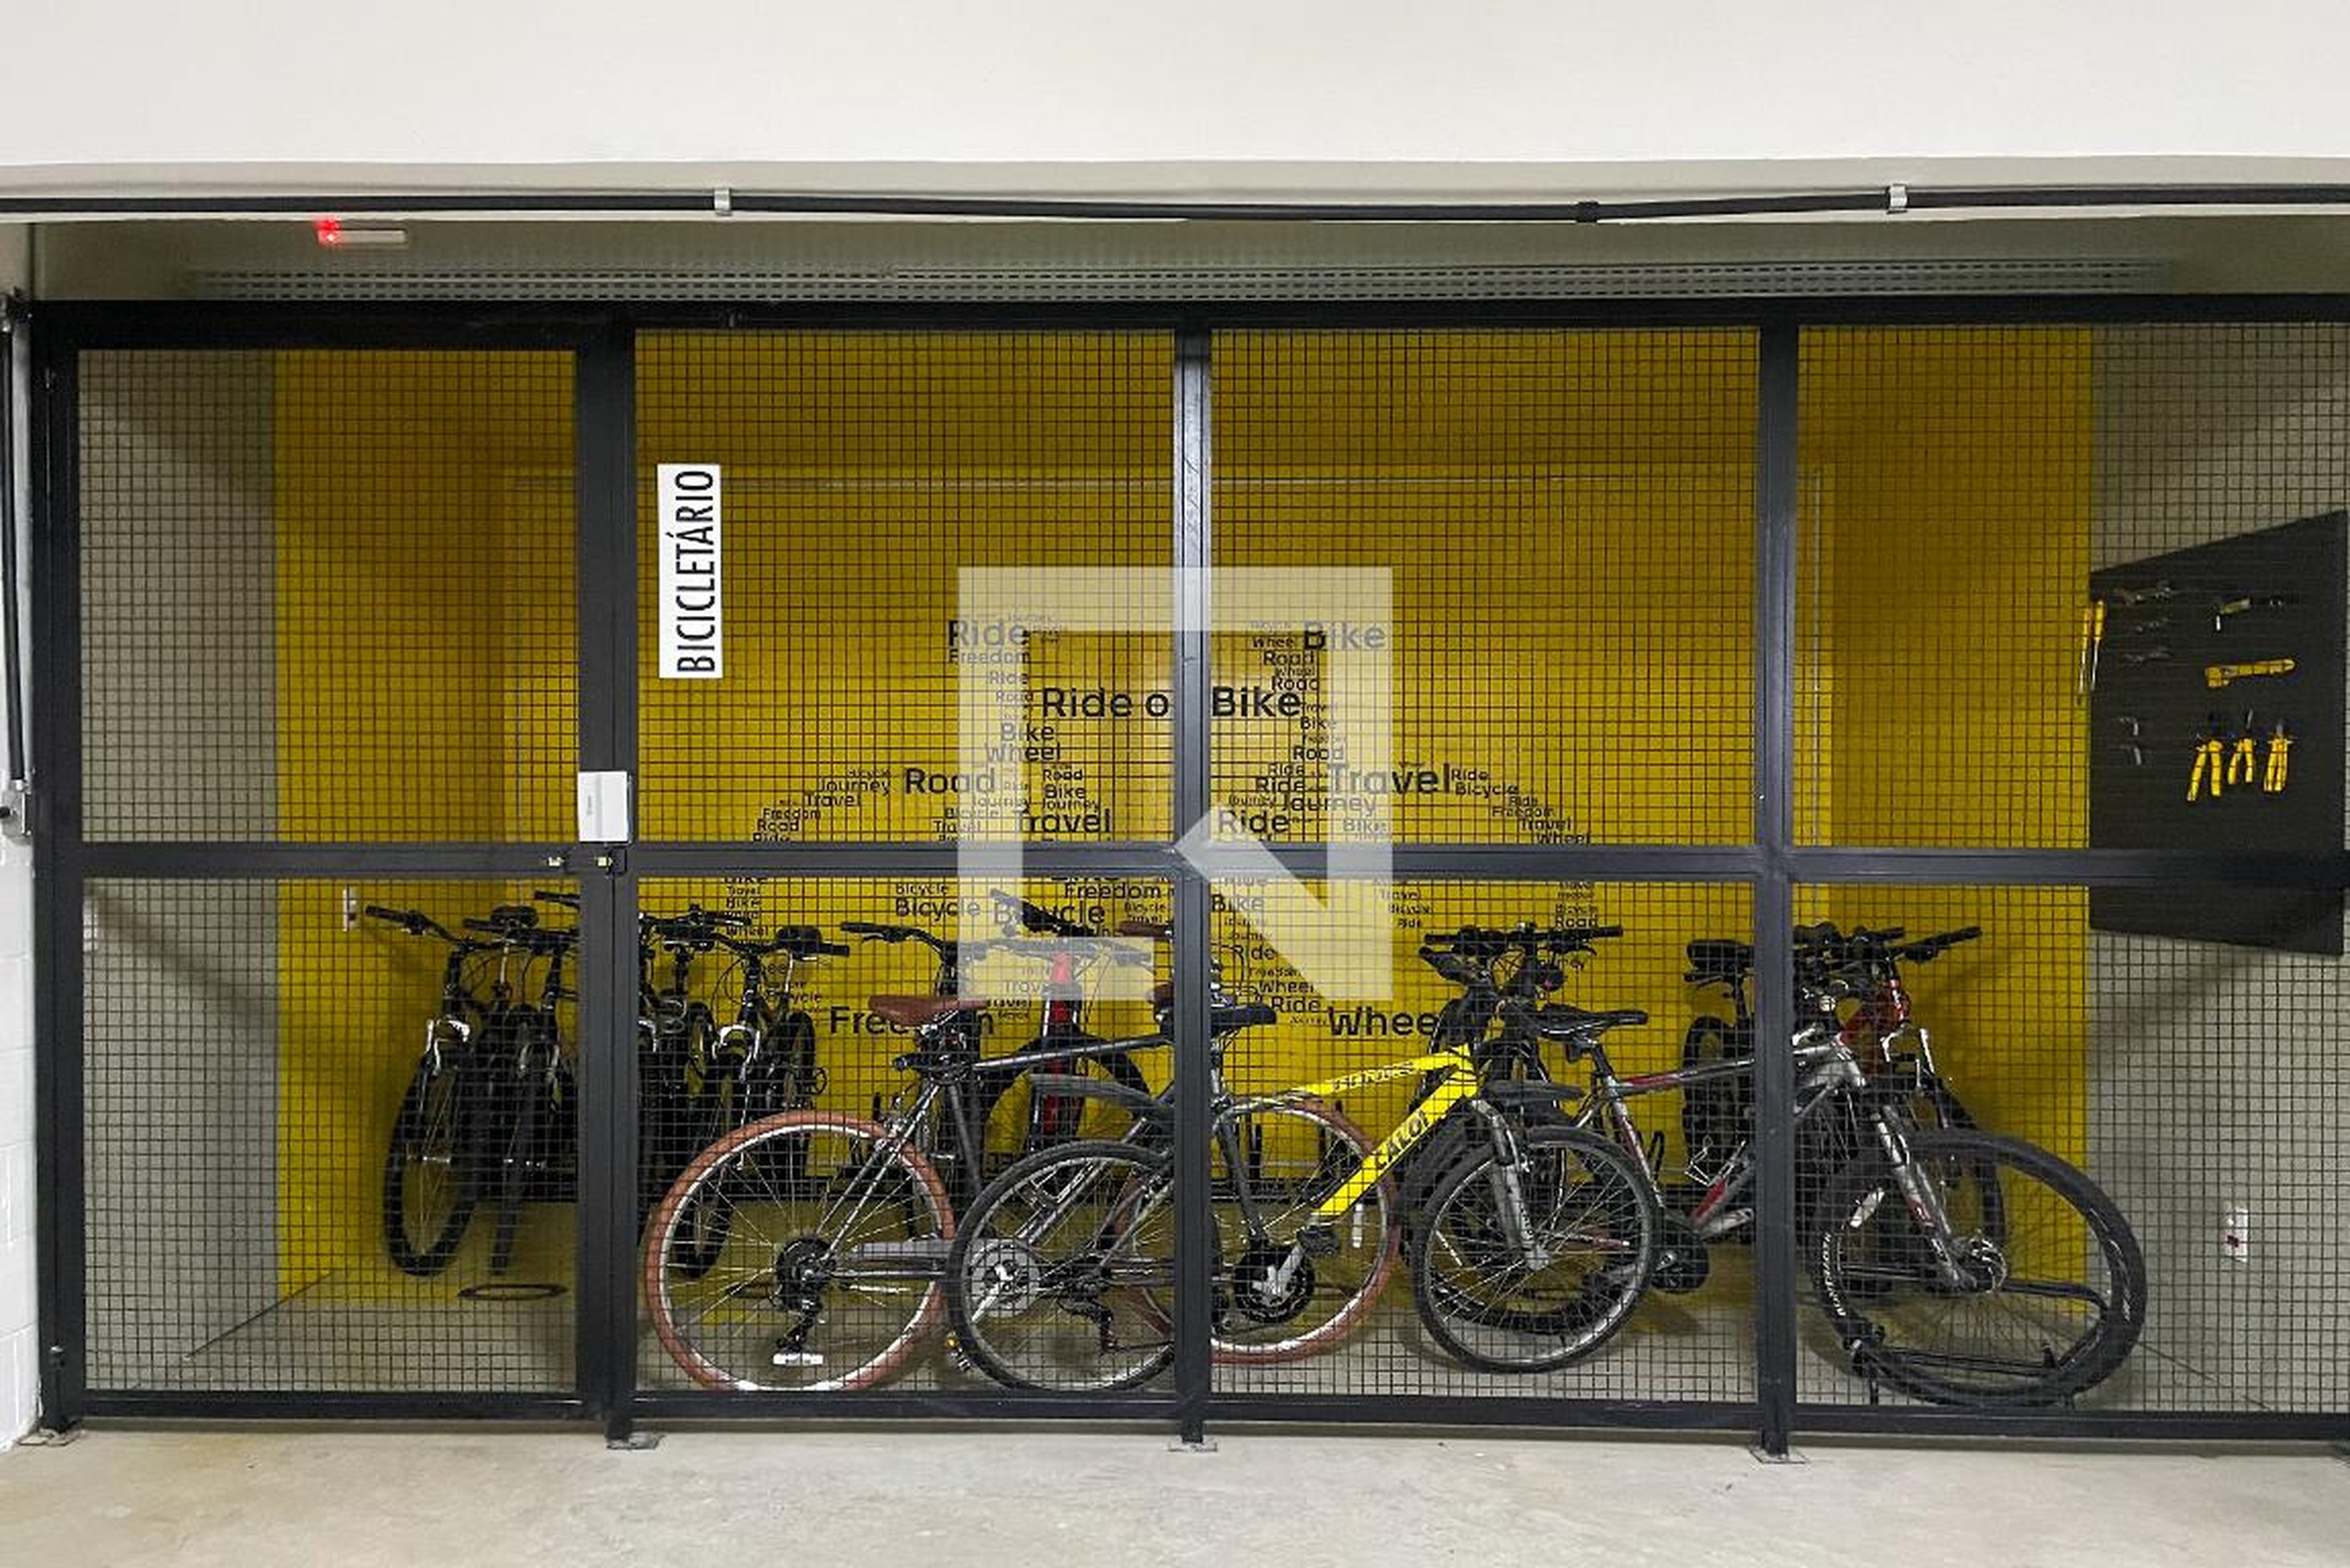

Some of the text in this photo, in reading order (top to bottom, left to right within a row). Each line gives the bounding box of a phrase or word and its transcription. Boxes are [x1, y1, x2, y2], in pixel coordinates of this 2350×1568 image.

[665, 471, 715, 671] BICICLETÁRIO
[948, 619, 1029, 646] Ride
[1304, 621, 1386, 650] Bike
[949, 649, 1031, 664] Freedom
[1042, 685, 1301, 717] Ride o Bike
[1001, 722, 1054, 742] Bike
[985, 742, 1061, 763] Wheel
[905, 768, 995, 794] Road
[1042, 769, 1083, 781] Road
[1327, 763, 1450, 794] Travel
[1451, 768, 1490, 781] Ride
[820, 779, 890, 796] Journey
[1044, 784, 1087, 799] Bike
[1256, 777, 1305, 794] Ride
[1455, 782, 1519, 799] Bicycle
[804, 793, 861, 807] Travel
[1282, 793, 1376, 816] Journey
[1012, 807, 1111, 833] Travel
[1217, 809, 1289, 834] Ride
[1064, 881, 1161, 899] Freedom
[896, 897, 980, 922] Bicycle
[994, 901, 1105, 924] Bcle
[1211, 894, 1264, 912] Bike
[1271, 995, 1321, 1013] Ride
[1328, 1005, 1436, 1037] Whee
